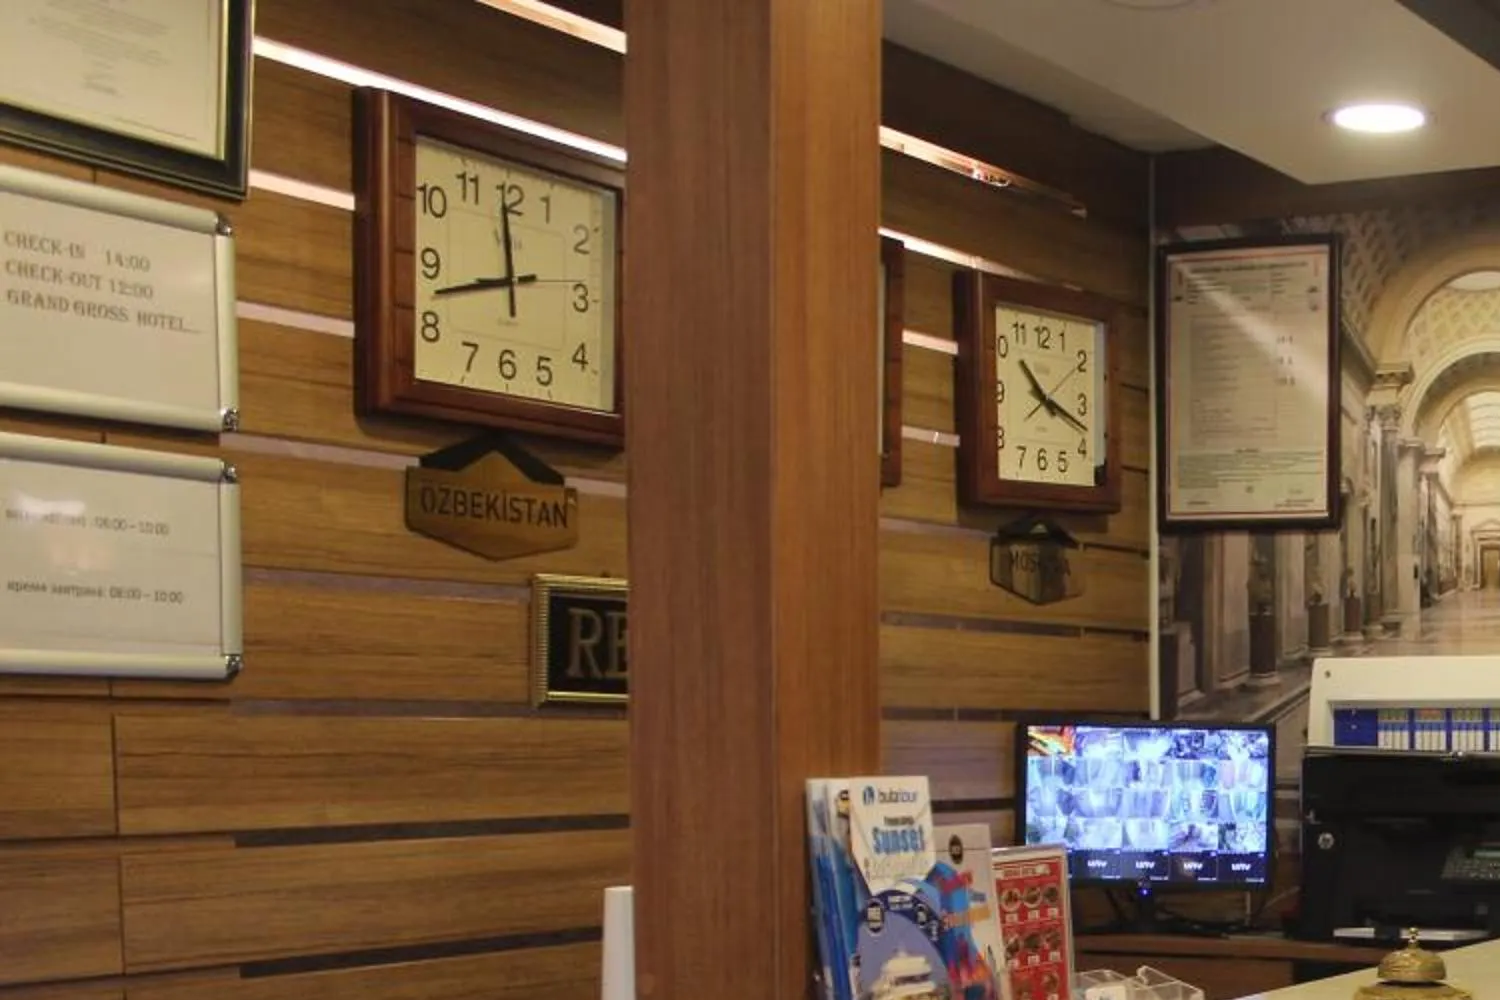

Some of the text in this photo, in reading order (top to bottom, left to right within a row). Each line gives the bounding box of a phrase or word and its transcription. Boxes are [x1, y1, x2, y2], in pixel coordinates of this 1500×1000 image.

[417, 182, 447, 218] 10
[456, 171, 480, 205] 11
[495, 181, 524, 216] 12
[540, 196, 551, 224] 1
[4, 230, 151, 272] CHECK-IN 14:00
[573, 224, 590, 254] 2
[420, 247, 440, 280] 9
[5, 259, 154, 300] CHECK-OUT 12:00
[6, 288, 70, 313] GRAND
[573, 283, 589, 313] 3
[421, 310, 440, 343] 8
[1034, 326, 1051, 350] 12
[461, 341, 479, 372] 7
[572, 342, 589, 371] 4
[997, 335, 1009, 358] 0
[499, 349, 517, 380] 6
[536, 355, 553, 386] 5
[420, 480, 568, 529] ÖZBEKİSTAN
